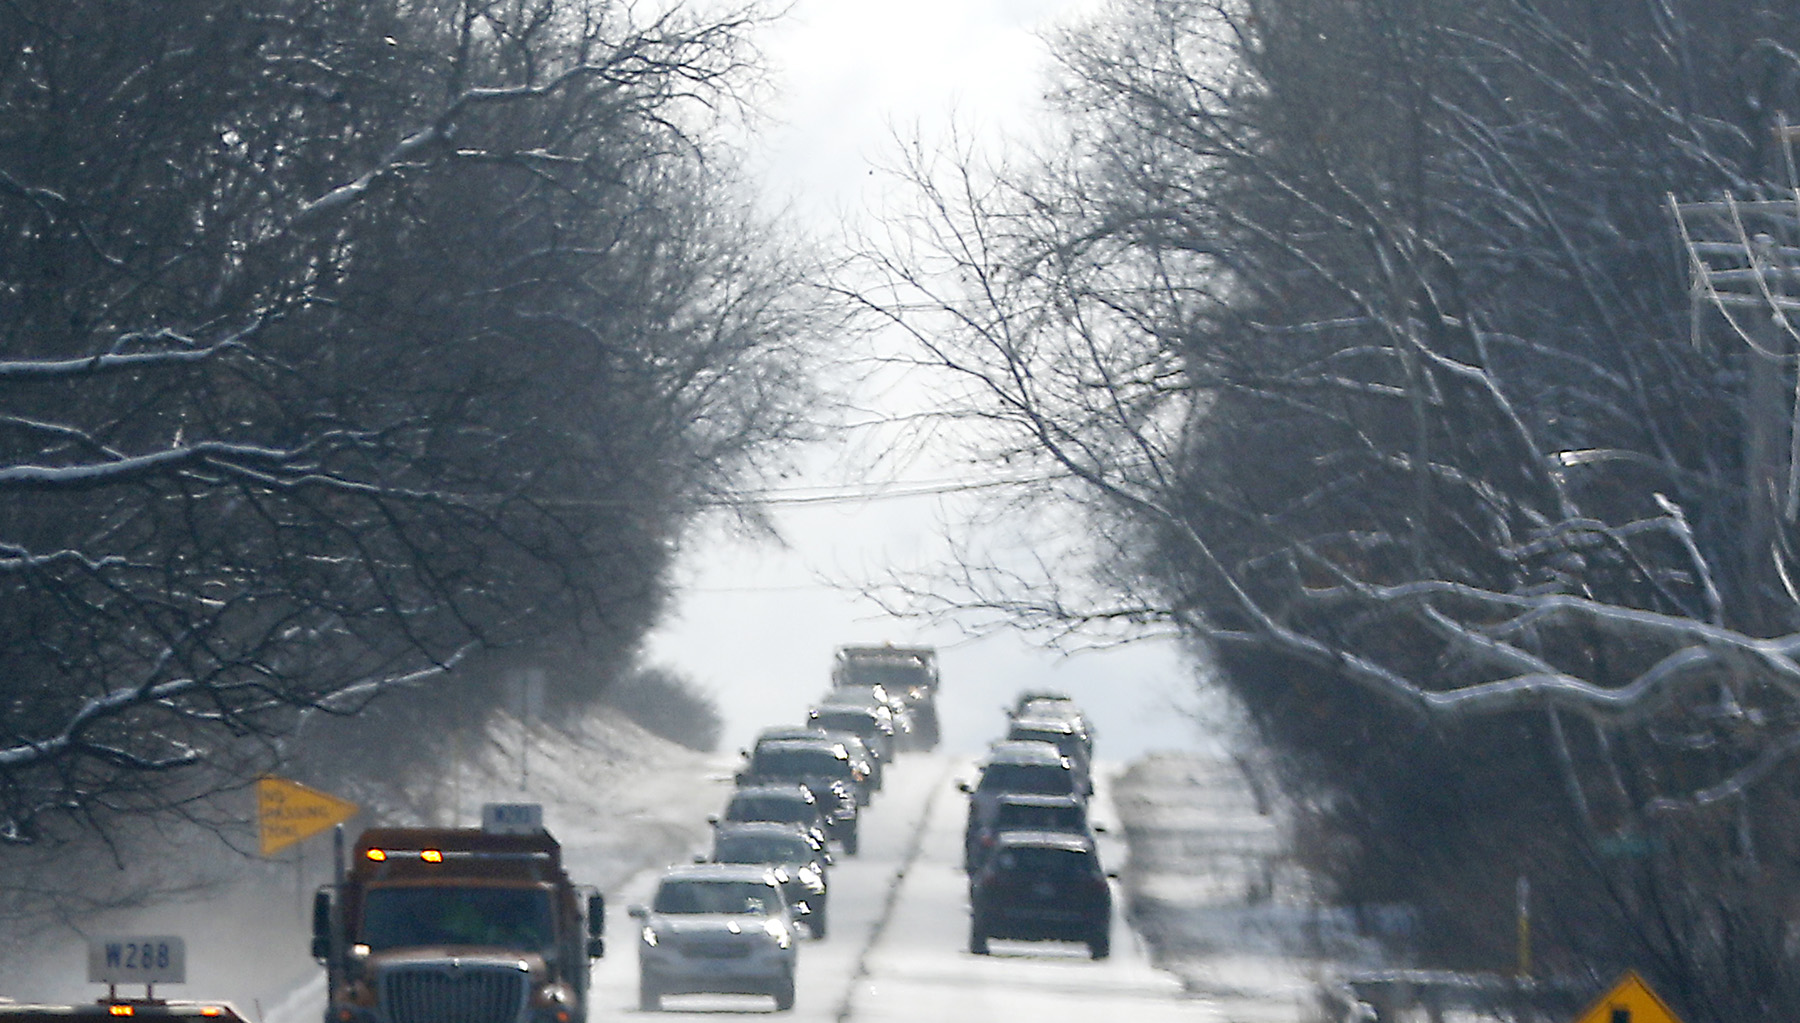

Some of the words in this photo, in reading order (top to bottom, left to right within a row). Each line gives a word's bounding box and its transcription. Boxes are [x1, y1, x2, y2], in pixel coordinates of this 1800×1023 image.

[263, 789, 285, 803] NO
[262, 805, 329, 819] PASSING
[105, 943, 169, 969] W288
